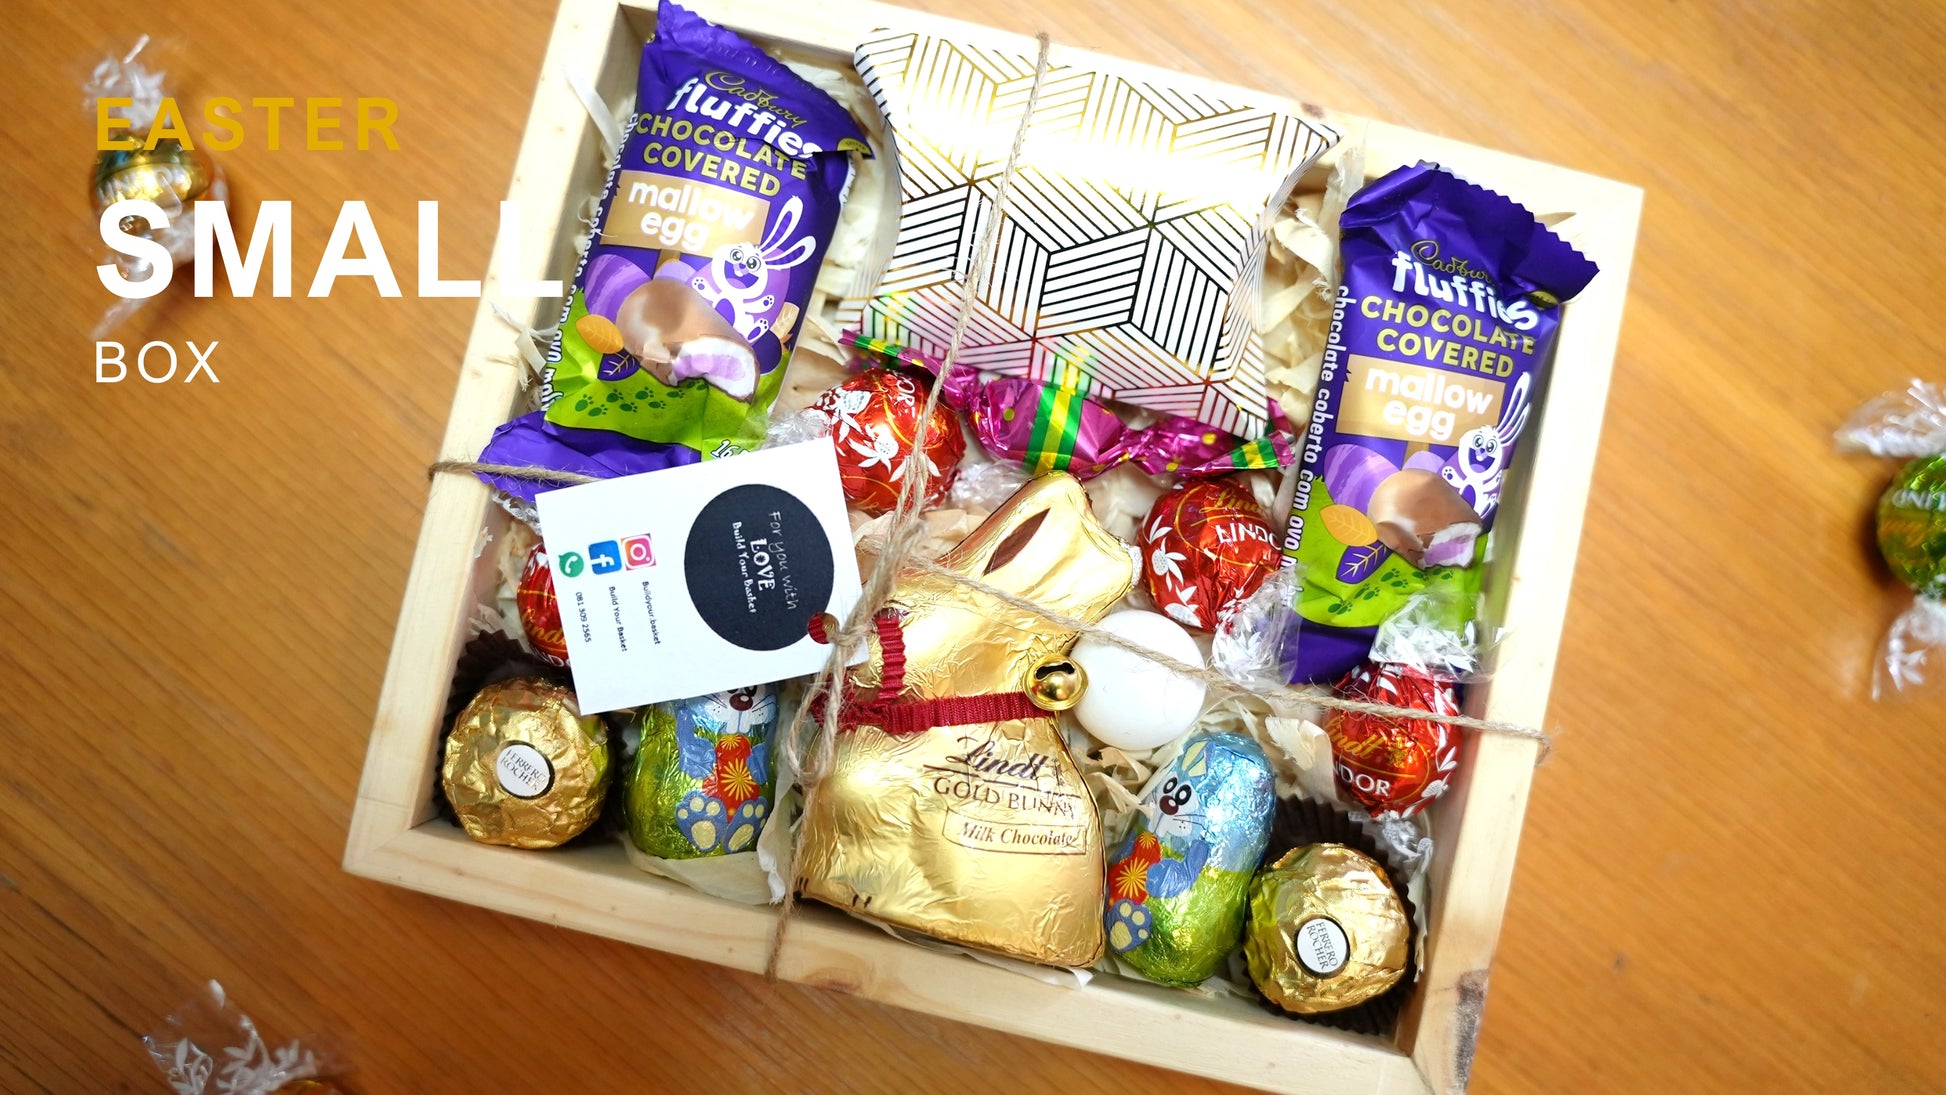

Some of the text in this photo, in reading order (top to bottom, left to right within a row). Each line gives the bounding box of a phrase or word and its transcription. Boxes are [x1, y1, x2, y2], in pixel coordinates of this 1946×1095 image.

[705, 71, 808, 128] Cadbury
[601, 113, 638, 200] chocolate
[636, 113, 807, 181] CHOCOLATE
[643, 142, 781, 198] COVERED
[628, 181, 756, 231] mallow
[640, 211, 711, 250] egg
[1411, 240, 1493, 283] Cadbur
[1321, 285, 1357, 383] chocolate
[1360, 295, 1535, 355] CHOCOLATE
[1376, 328, 1514, 378] COVERED
[1365, 367, 1494, 415] mallow
[1303, 388, 1334, 464] coberto
[1383, 400, 1456, 442] egg
[1293, 469, 1314, 511] com
[1284, 515, 1304, 551] ovo
[732, 521, 757, 613] Build Your Basket
[750, 538, 776, 591] LOVE
[768, 510, 799, 610] For you with
[575, 591, 584, 606] 081
[609, 586, 628, 652] Build Your Basket
[501, 757, 537, 791] ROCHER
[506, 749, 546, 783] FERRERO
[945, 737, 1049, 780] Lindt
[1333, 762, 1390, 797] DOR
[933, 777, 1075, 819] GOLD BUNNY
[957, 821, 1074, 847] Milk Chocolate
[1307, 925, 1329, 970] ROCHER
[1315, 922, 1338, 967] FERRERO
